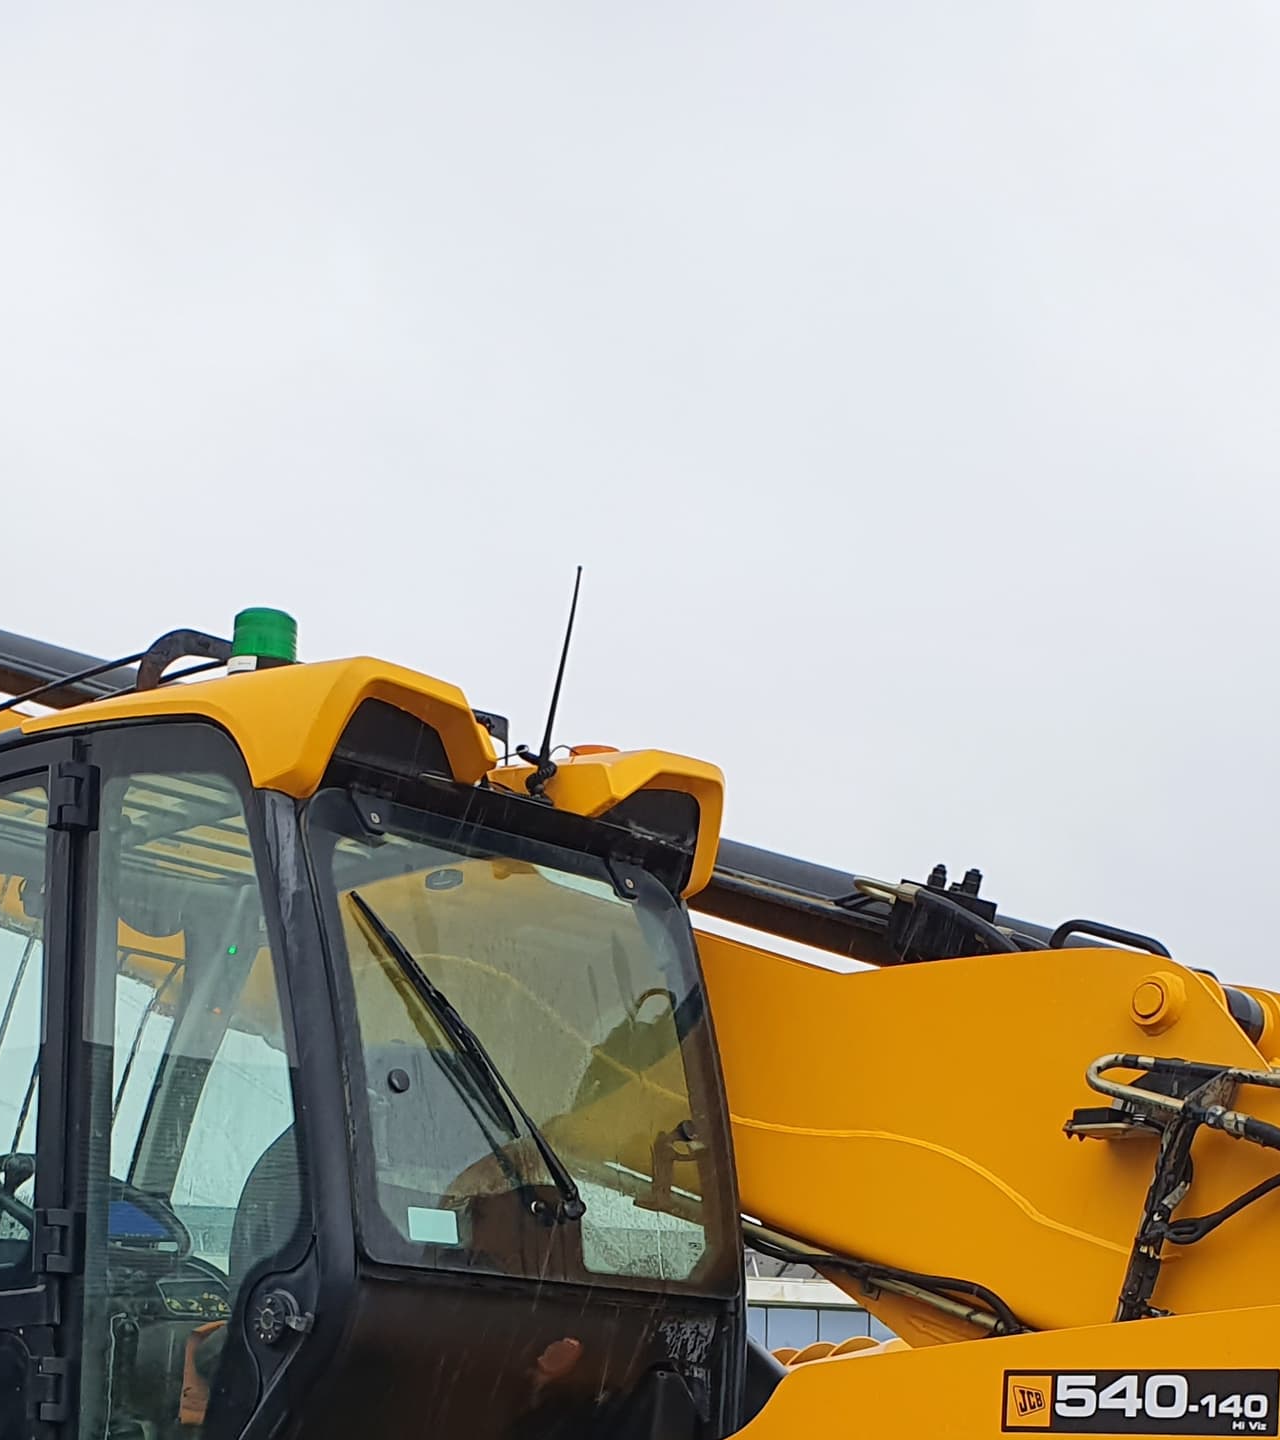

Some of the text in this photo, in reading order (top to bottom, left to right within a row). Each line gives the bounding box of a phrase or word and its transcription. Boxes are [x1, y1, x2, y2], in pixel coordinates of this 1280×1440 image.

[1016, 1374, 1269, 1419] JCB 540-140
[1232, 1421, 1268, 1431] Hi Viz
